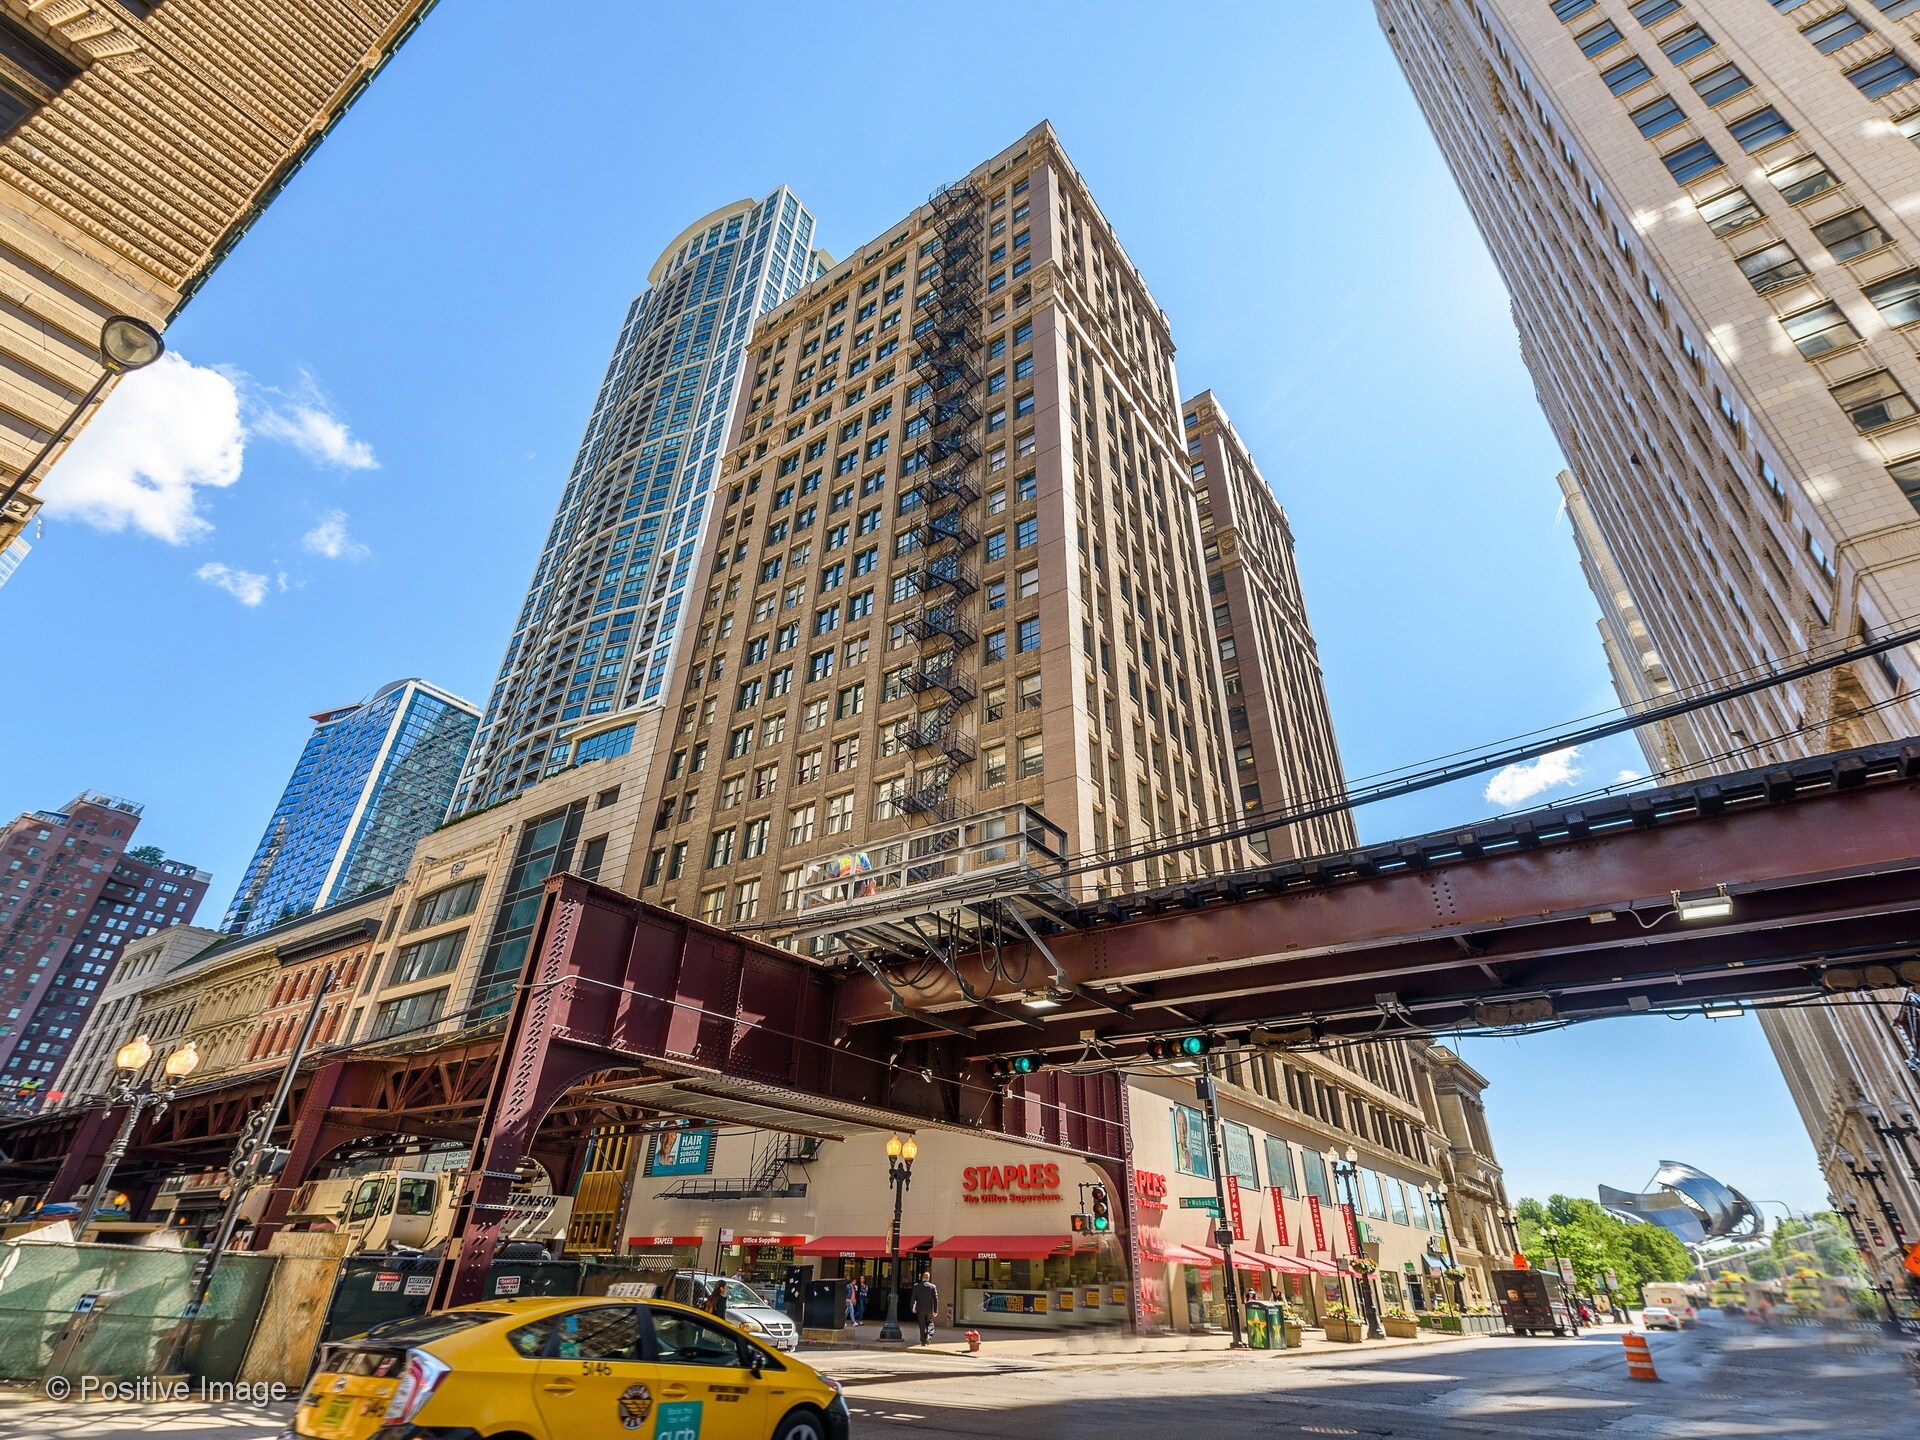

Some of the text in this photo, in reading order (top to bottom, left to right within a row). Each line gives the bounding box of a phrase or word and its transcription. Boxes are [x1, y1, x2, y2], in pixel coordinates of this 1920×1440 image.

[681, 1135, 703, 1147] HAIR
[680, 1150, 701, 1158] SURGICAL
[679, 1156, 699, 1165] CENTER
[962, 1163, 1061, 1192] STAPLES
[1229, 1177, 1237, 1200] Copy
[962, 1194, 980, 1204] The
[980, 1193, 1008, 1203] Office
[1311, 1198, 1324, 1249] Technology
[1343, 1205, 1358, 1254] STAPLES
[653, 1237, 674, 1245] STAPLES
[758, 1236, 780, 1245] Supplies
[977, 1252, 997, 1260] STAPLES
[582, 1361, 612, 1376] 5146
